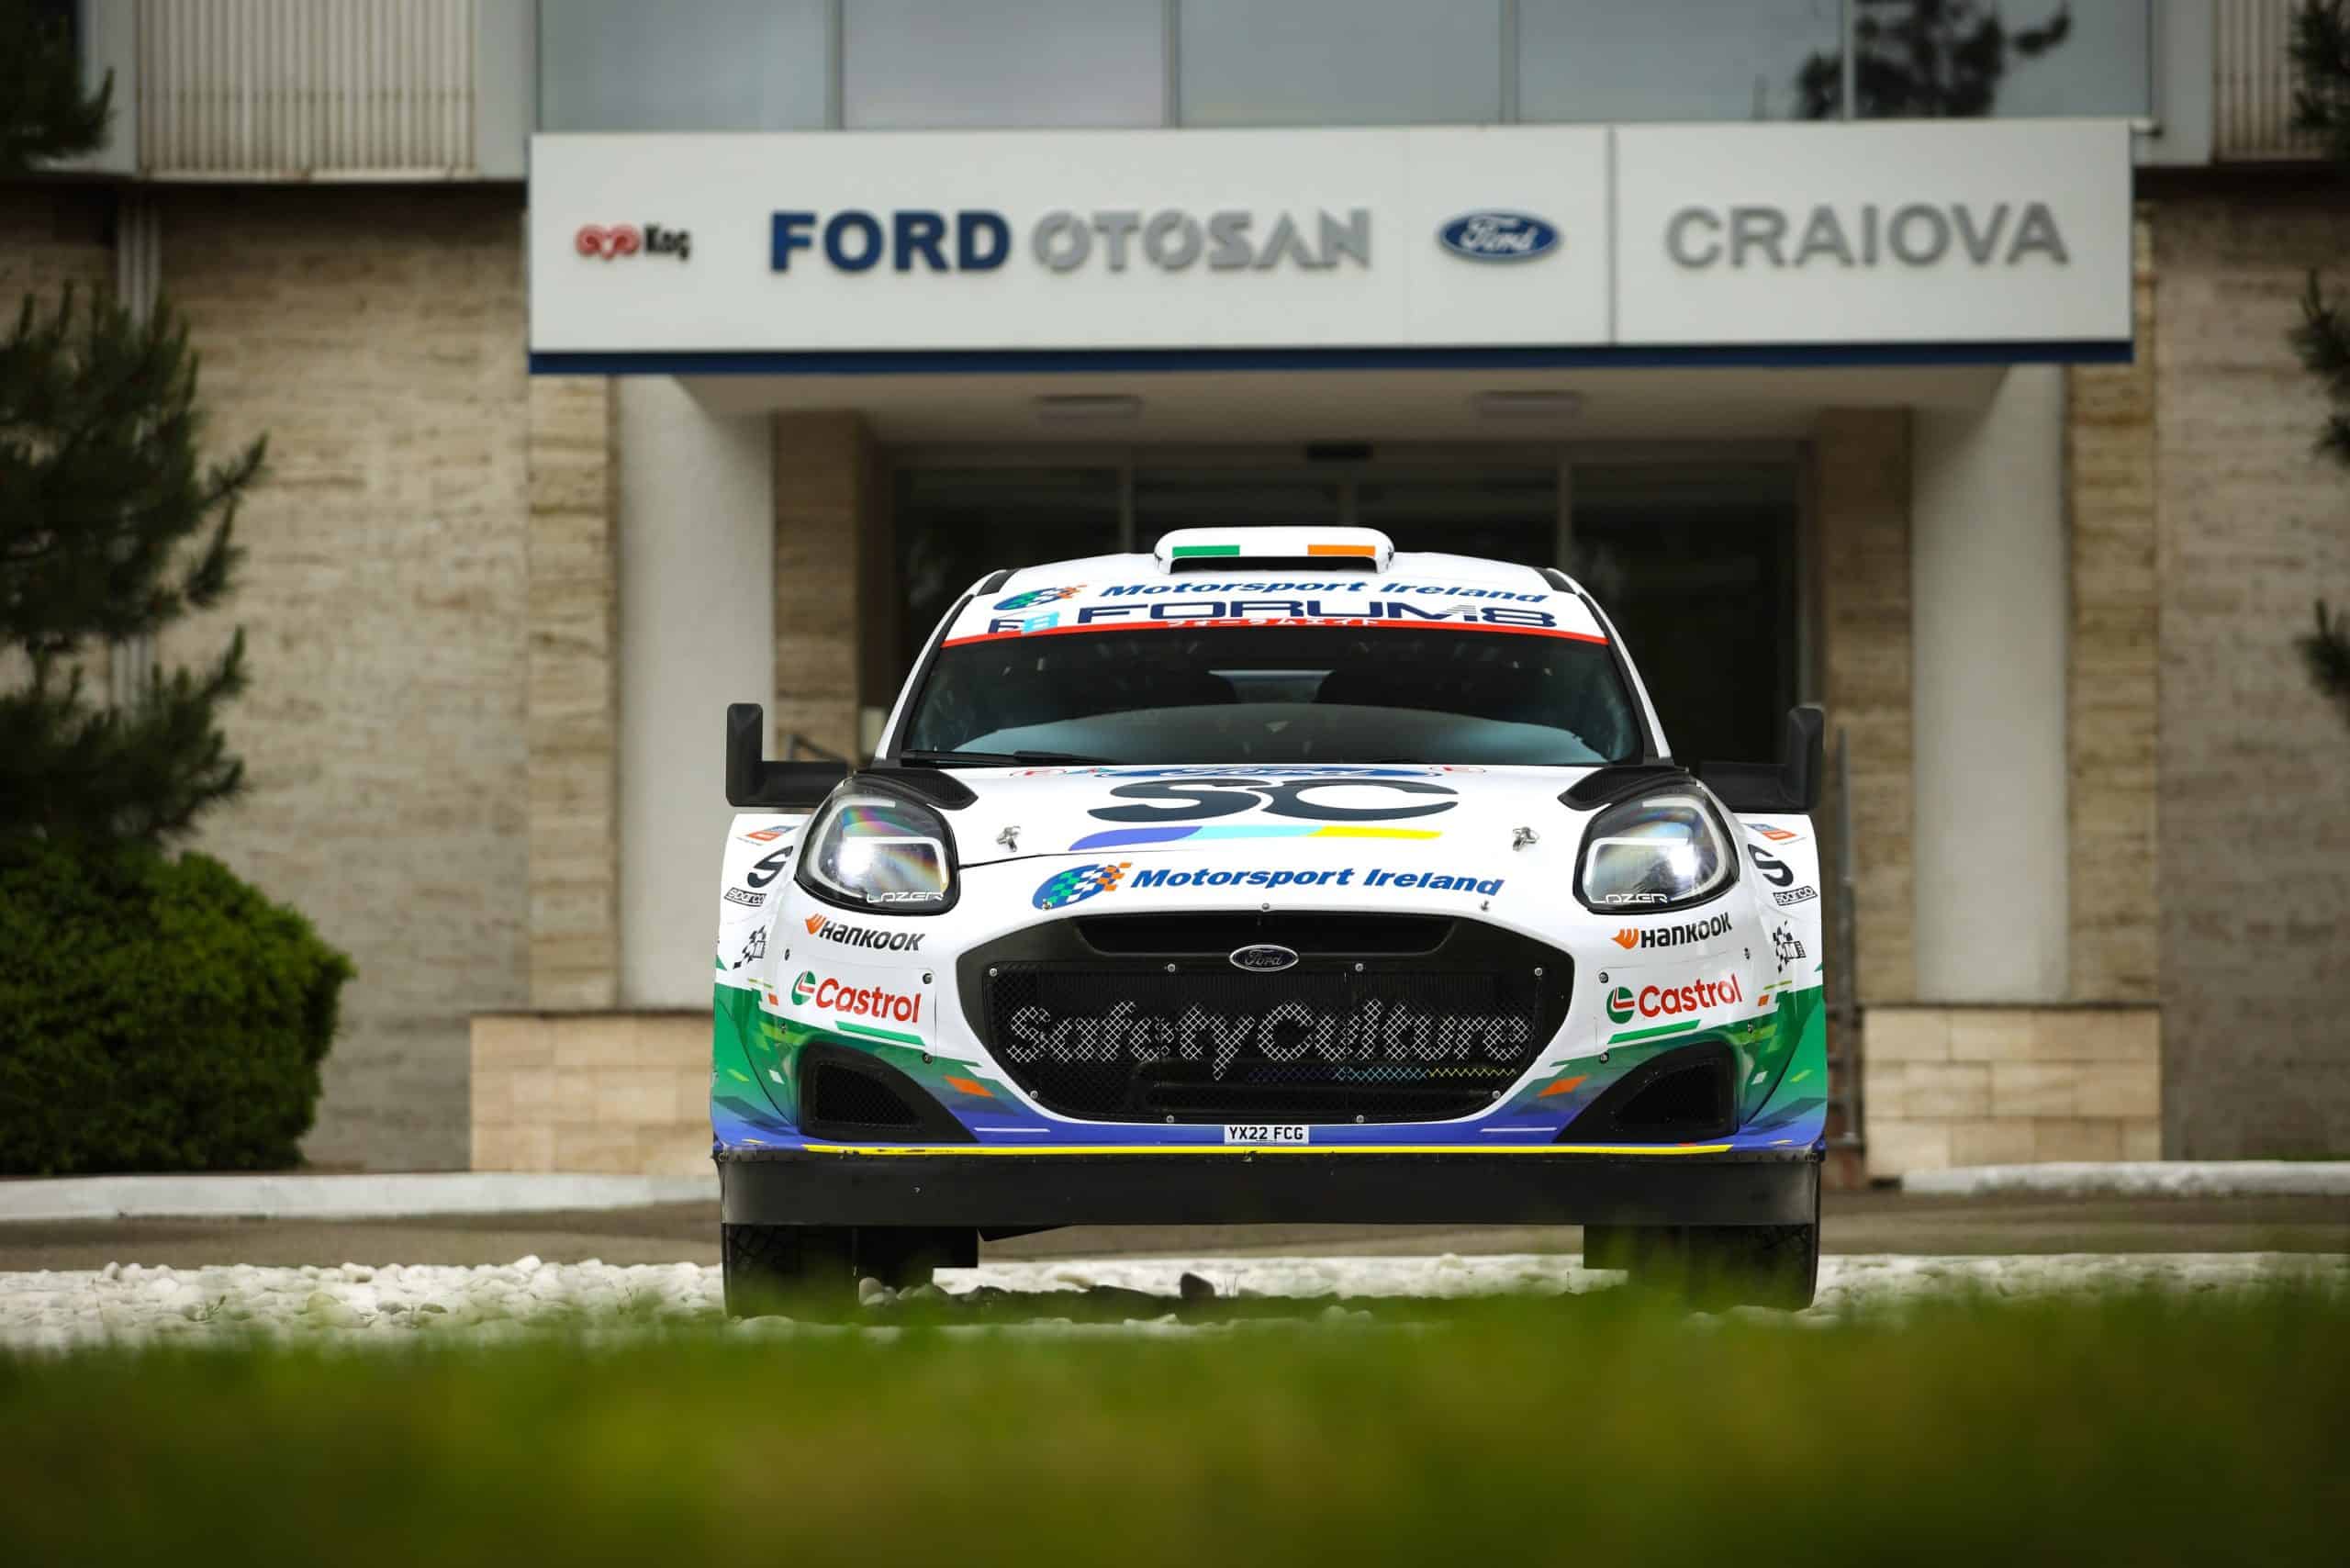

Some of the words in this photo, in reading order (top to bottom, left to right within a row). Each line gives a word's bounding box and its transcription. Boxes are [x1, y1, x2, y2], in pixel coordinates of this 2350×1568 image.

[643, 223, 691, 261] Koç
[770, 211, 1012, 274] FORD
[1030, 208, 1372, 274] OTOSAN
[1460, 215, 1539, 252] Ford
[1665, 201, 2070, 270] CRAIOVA
[1100, 580, 1367, 602] Motorsport
[1381, 582, 1550, 605] Ireland
[1077, 599, 1558, 629] FORUM8
[1087, 778, 1459, 823] SC
[1130, 868, 1354, 889] Motorsport
[1362, 868, 1505, 897] Ireland
[1244, 948, 1284, 967] Ford
[815, 978, 922, 1024] Castrol
[1639, 974, 1743, 1019] Castrol
[1008, 1000, 1531, 1081] SafetyCulture
[1229, 1126, 1269, 1140] YX22
[1273, 1126, 1304, 1140] FCG
